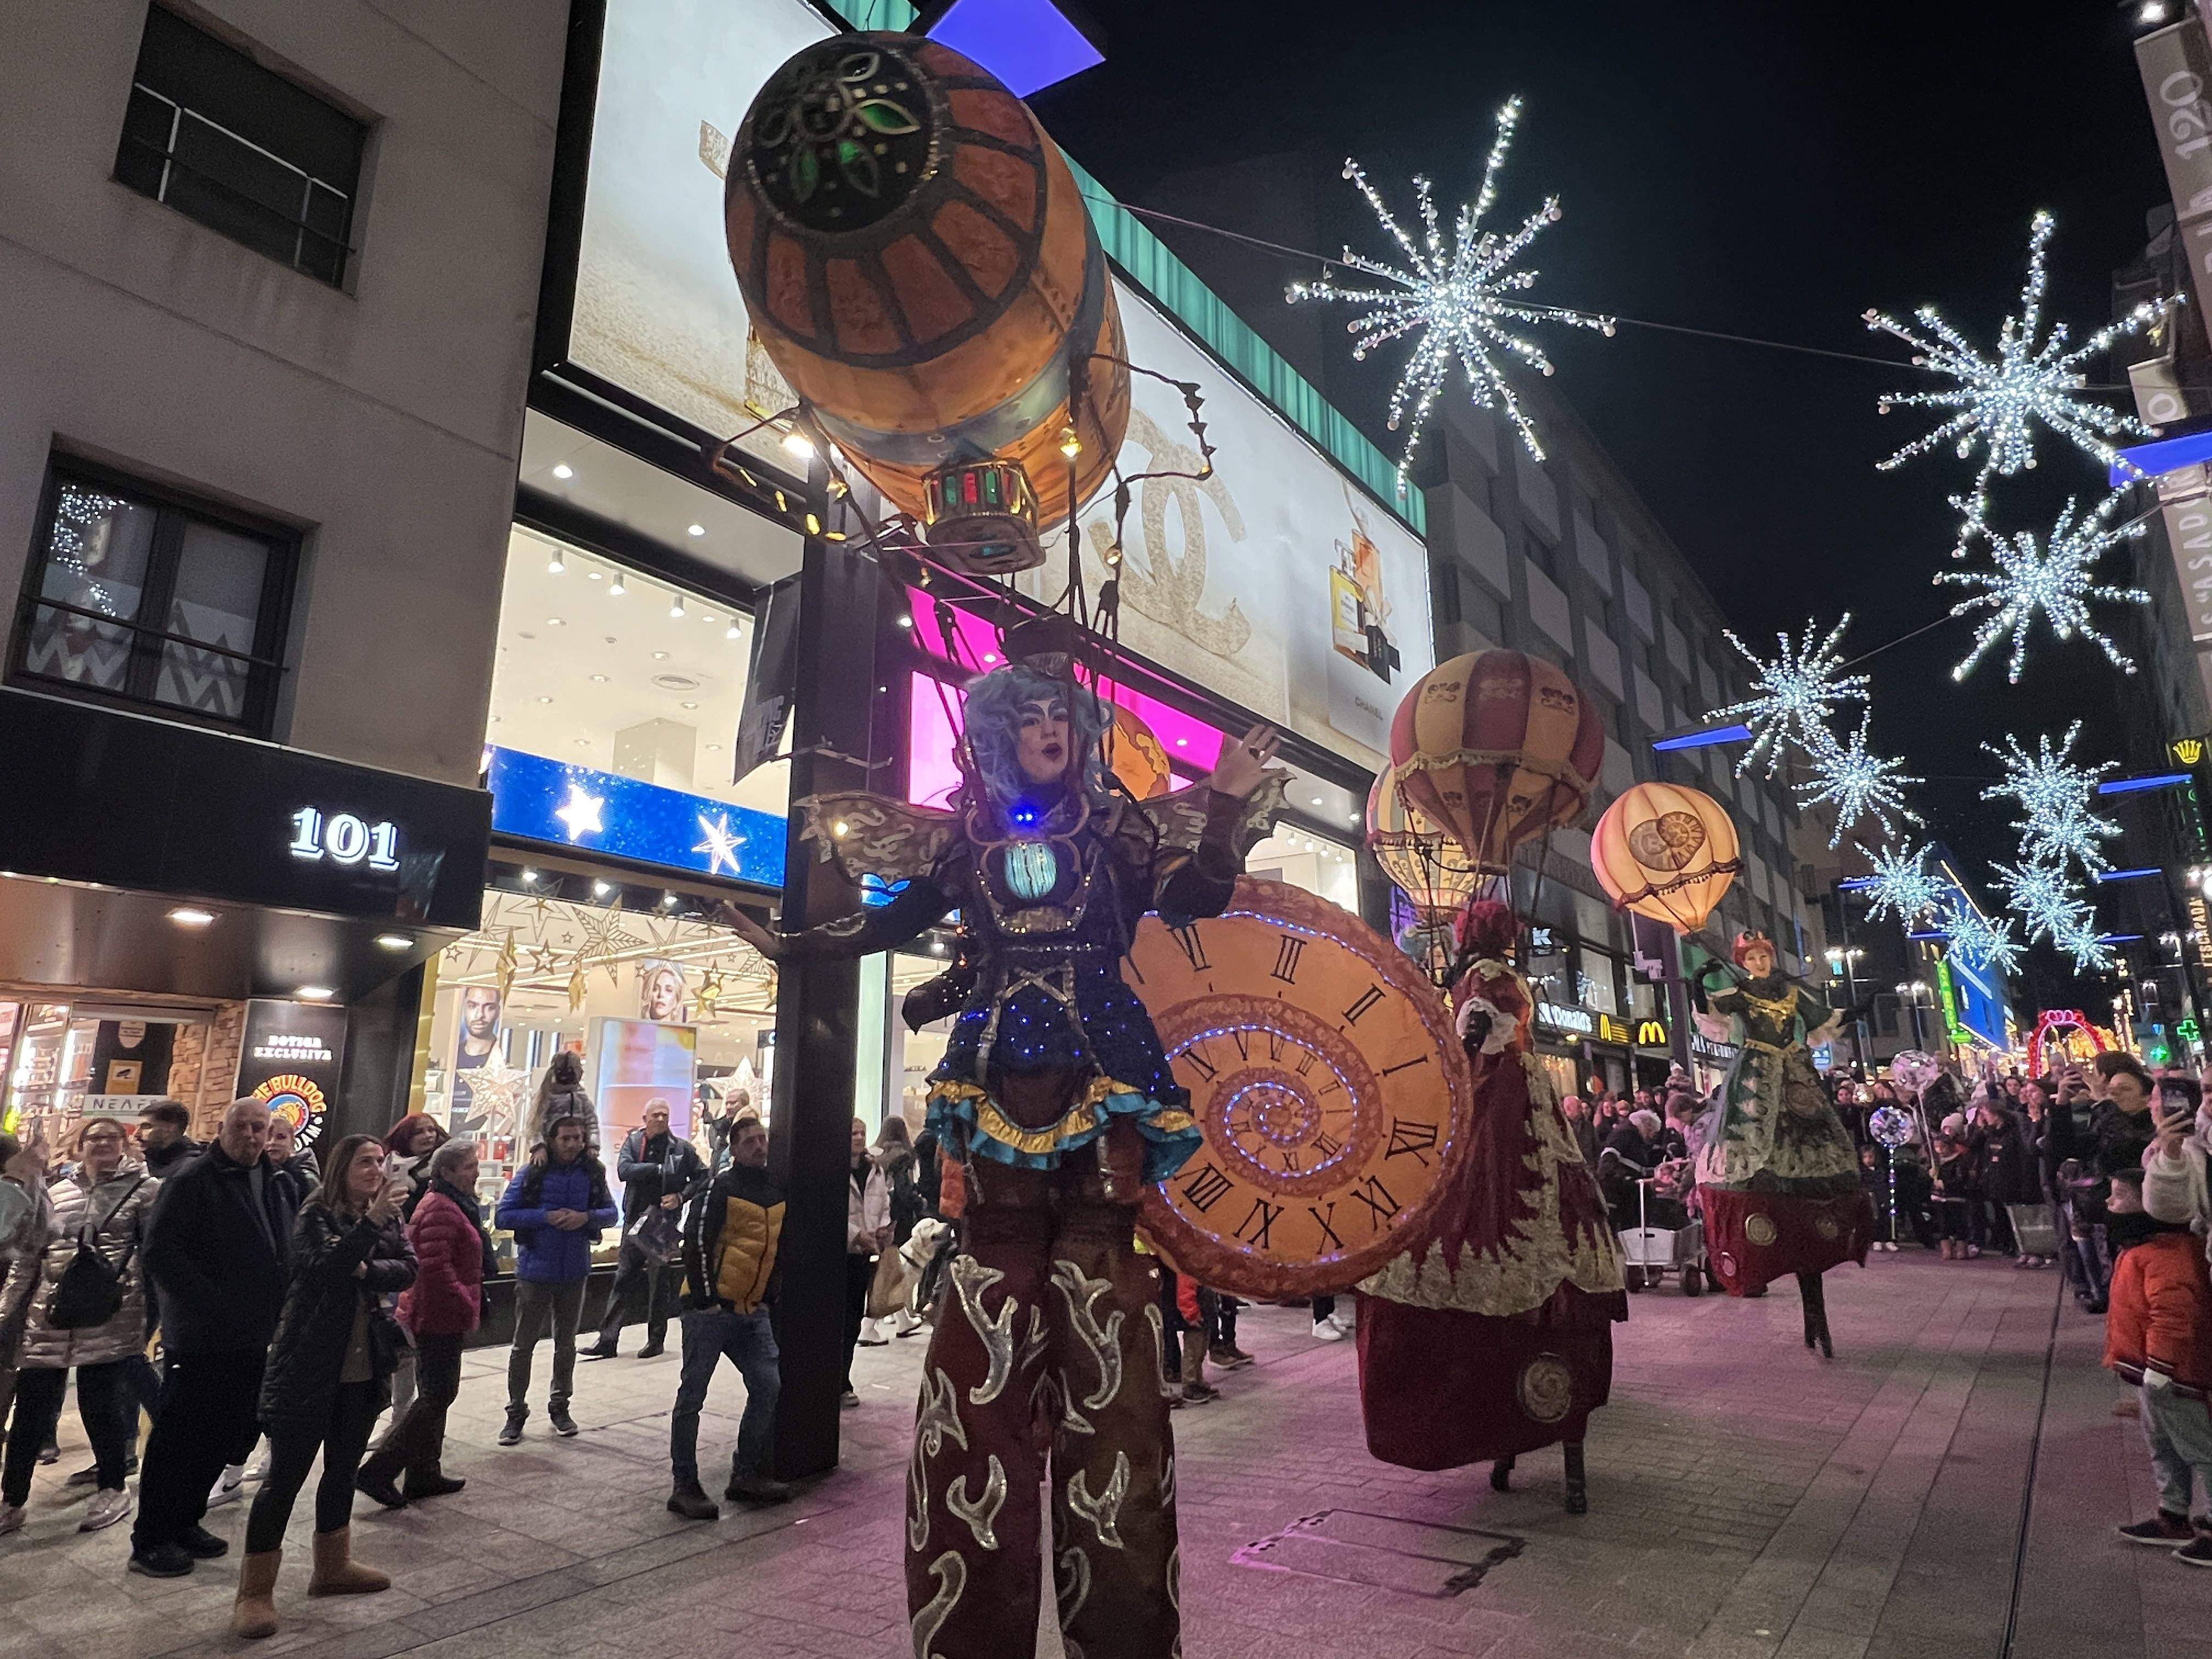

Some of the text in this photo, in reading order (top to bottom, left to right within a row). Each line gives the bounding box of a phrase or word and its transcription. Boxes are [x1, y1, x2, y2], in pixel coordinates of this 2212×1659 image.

[290, 806, 401, 871] 101
[253, 1047, 331, 1060] EXCLUSIVA
[269, 1074, 328, 1113] BULLDOG
